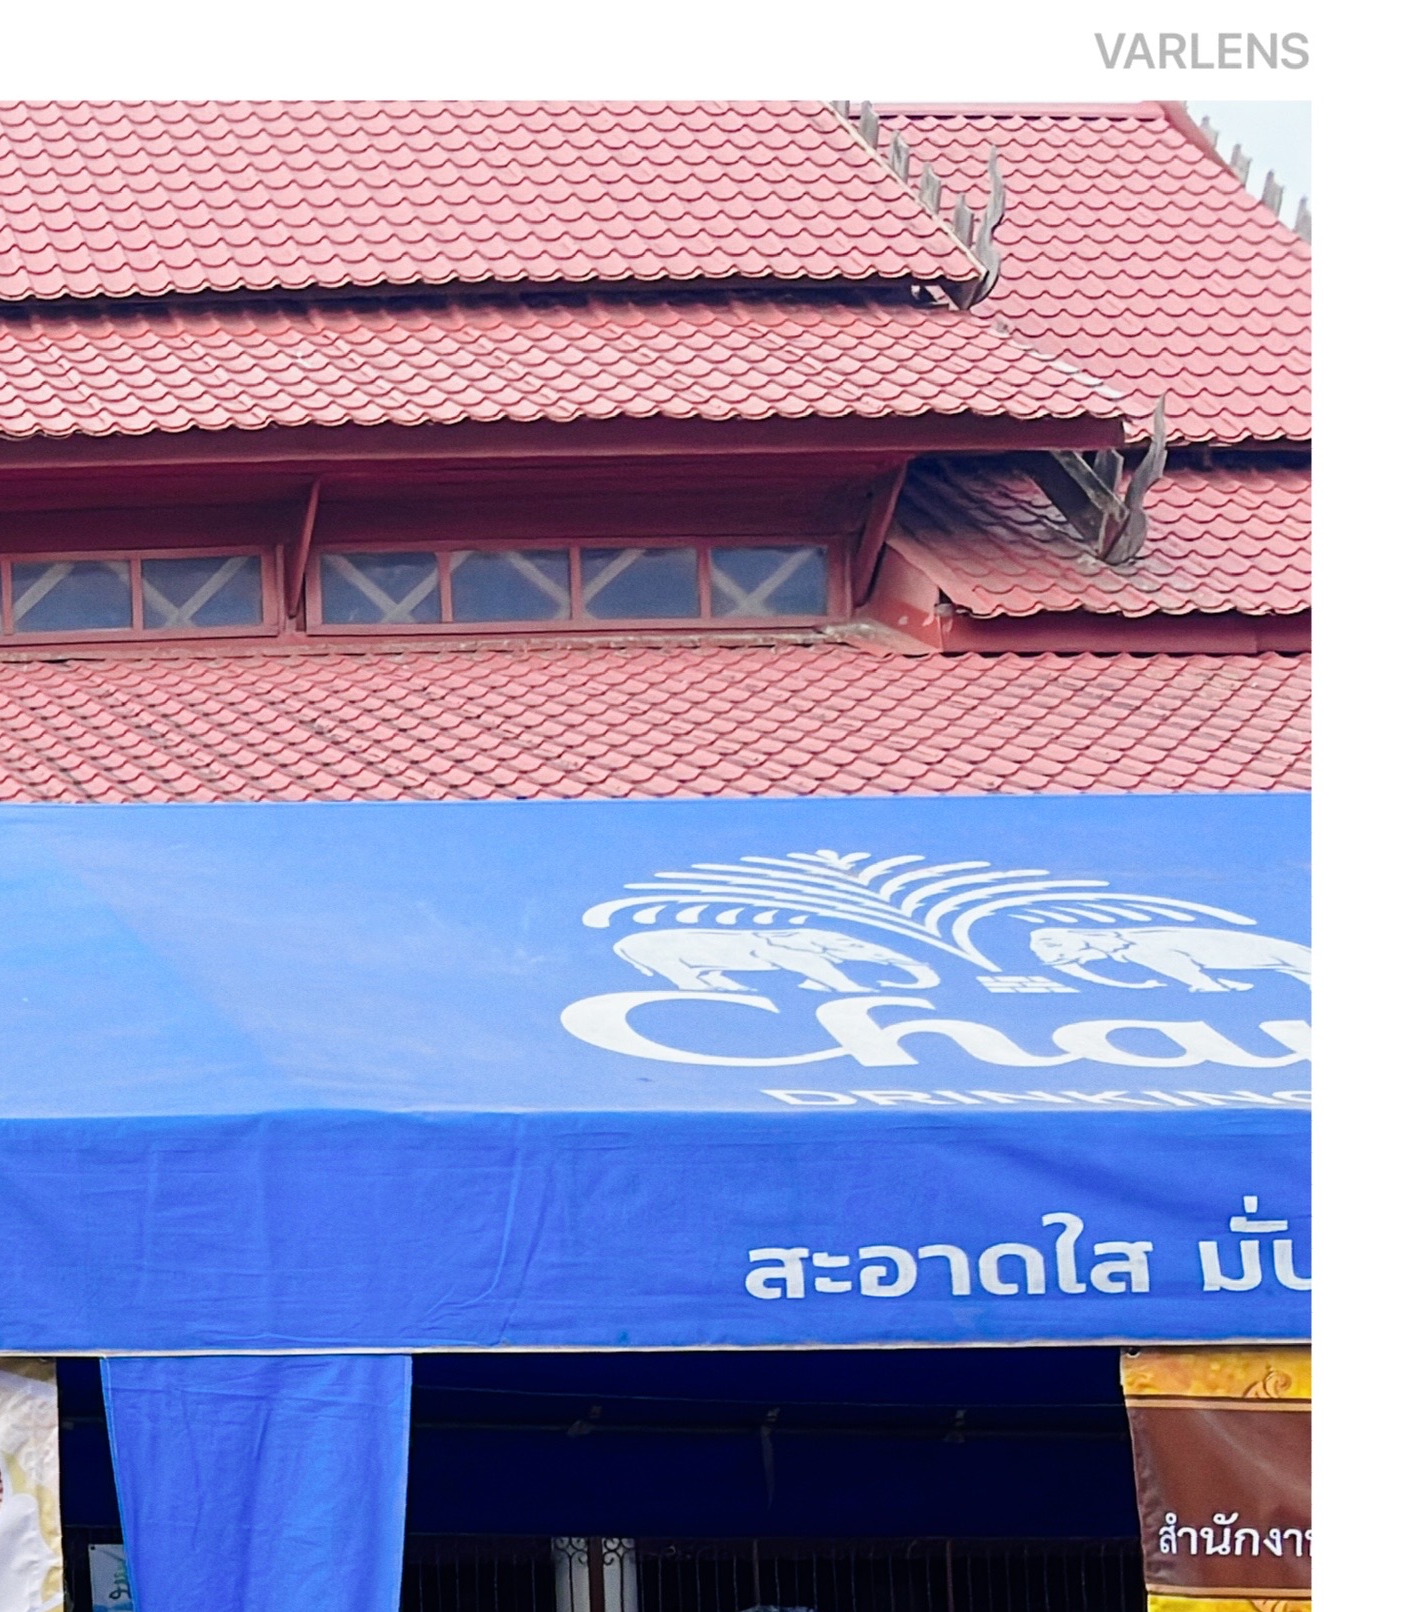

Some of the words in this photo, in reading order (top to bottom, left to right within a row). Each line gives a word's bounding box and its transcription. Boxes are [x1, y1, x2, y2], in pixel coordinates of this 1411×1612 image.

[745, 1212, 1154, 1299] สะอาดใส
[1158, 1511, 1311, 1558] สำนักงา
